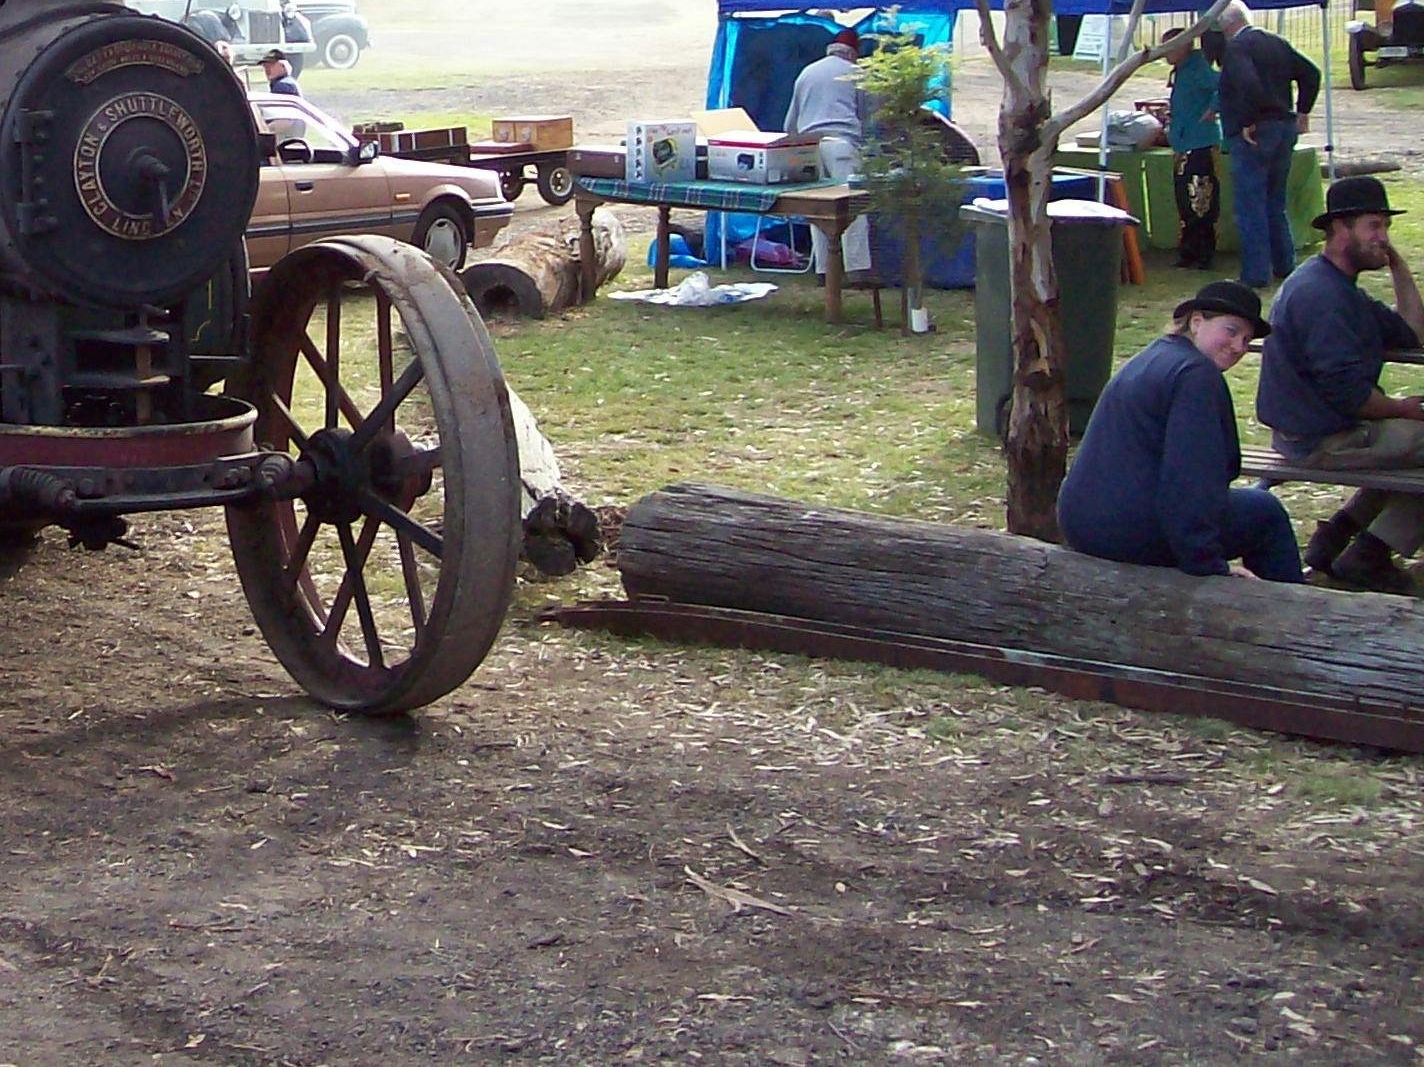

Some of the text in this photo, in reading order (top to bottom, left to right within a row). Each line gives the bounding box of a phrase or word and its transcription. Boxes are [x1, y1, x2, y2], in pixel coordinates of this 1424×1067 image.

[78, 133, 108, 216] CLAYTON
[97, 122, 108, 132] &
[105, 96, 203, 171] SHUTTLEWORTH
